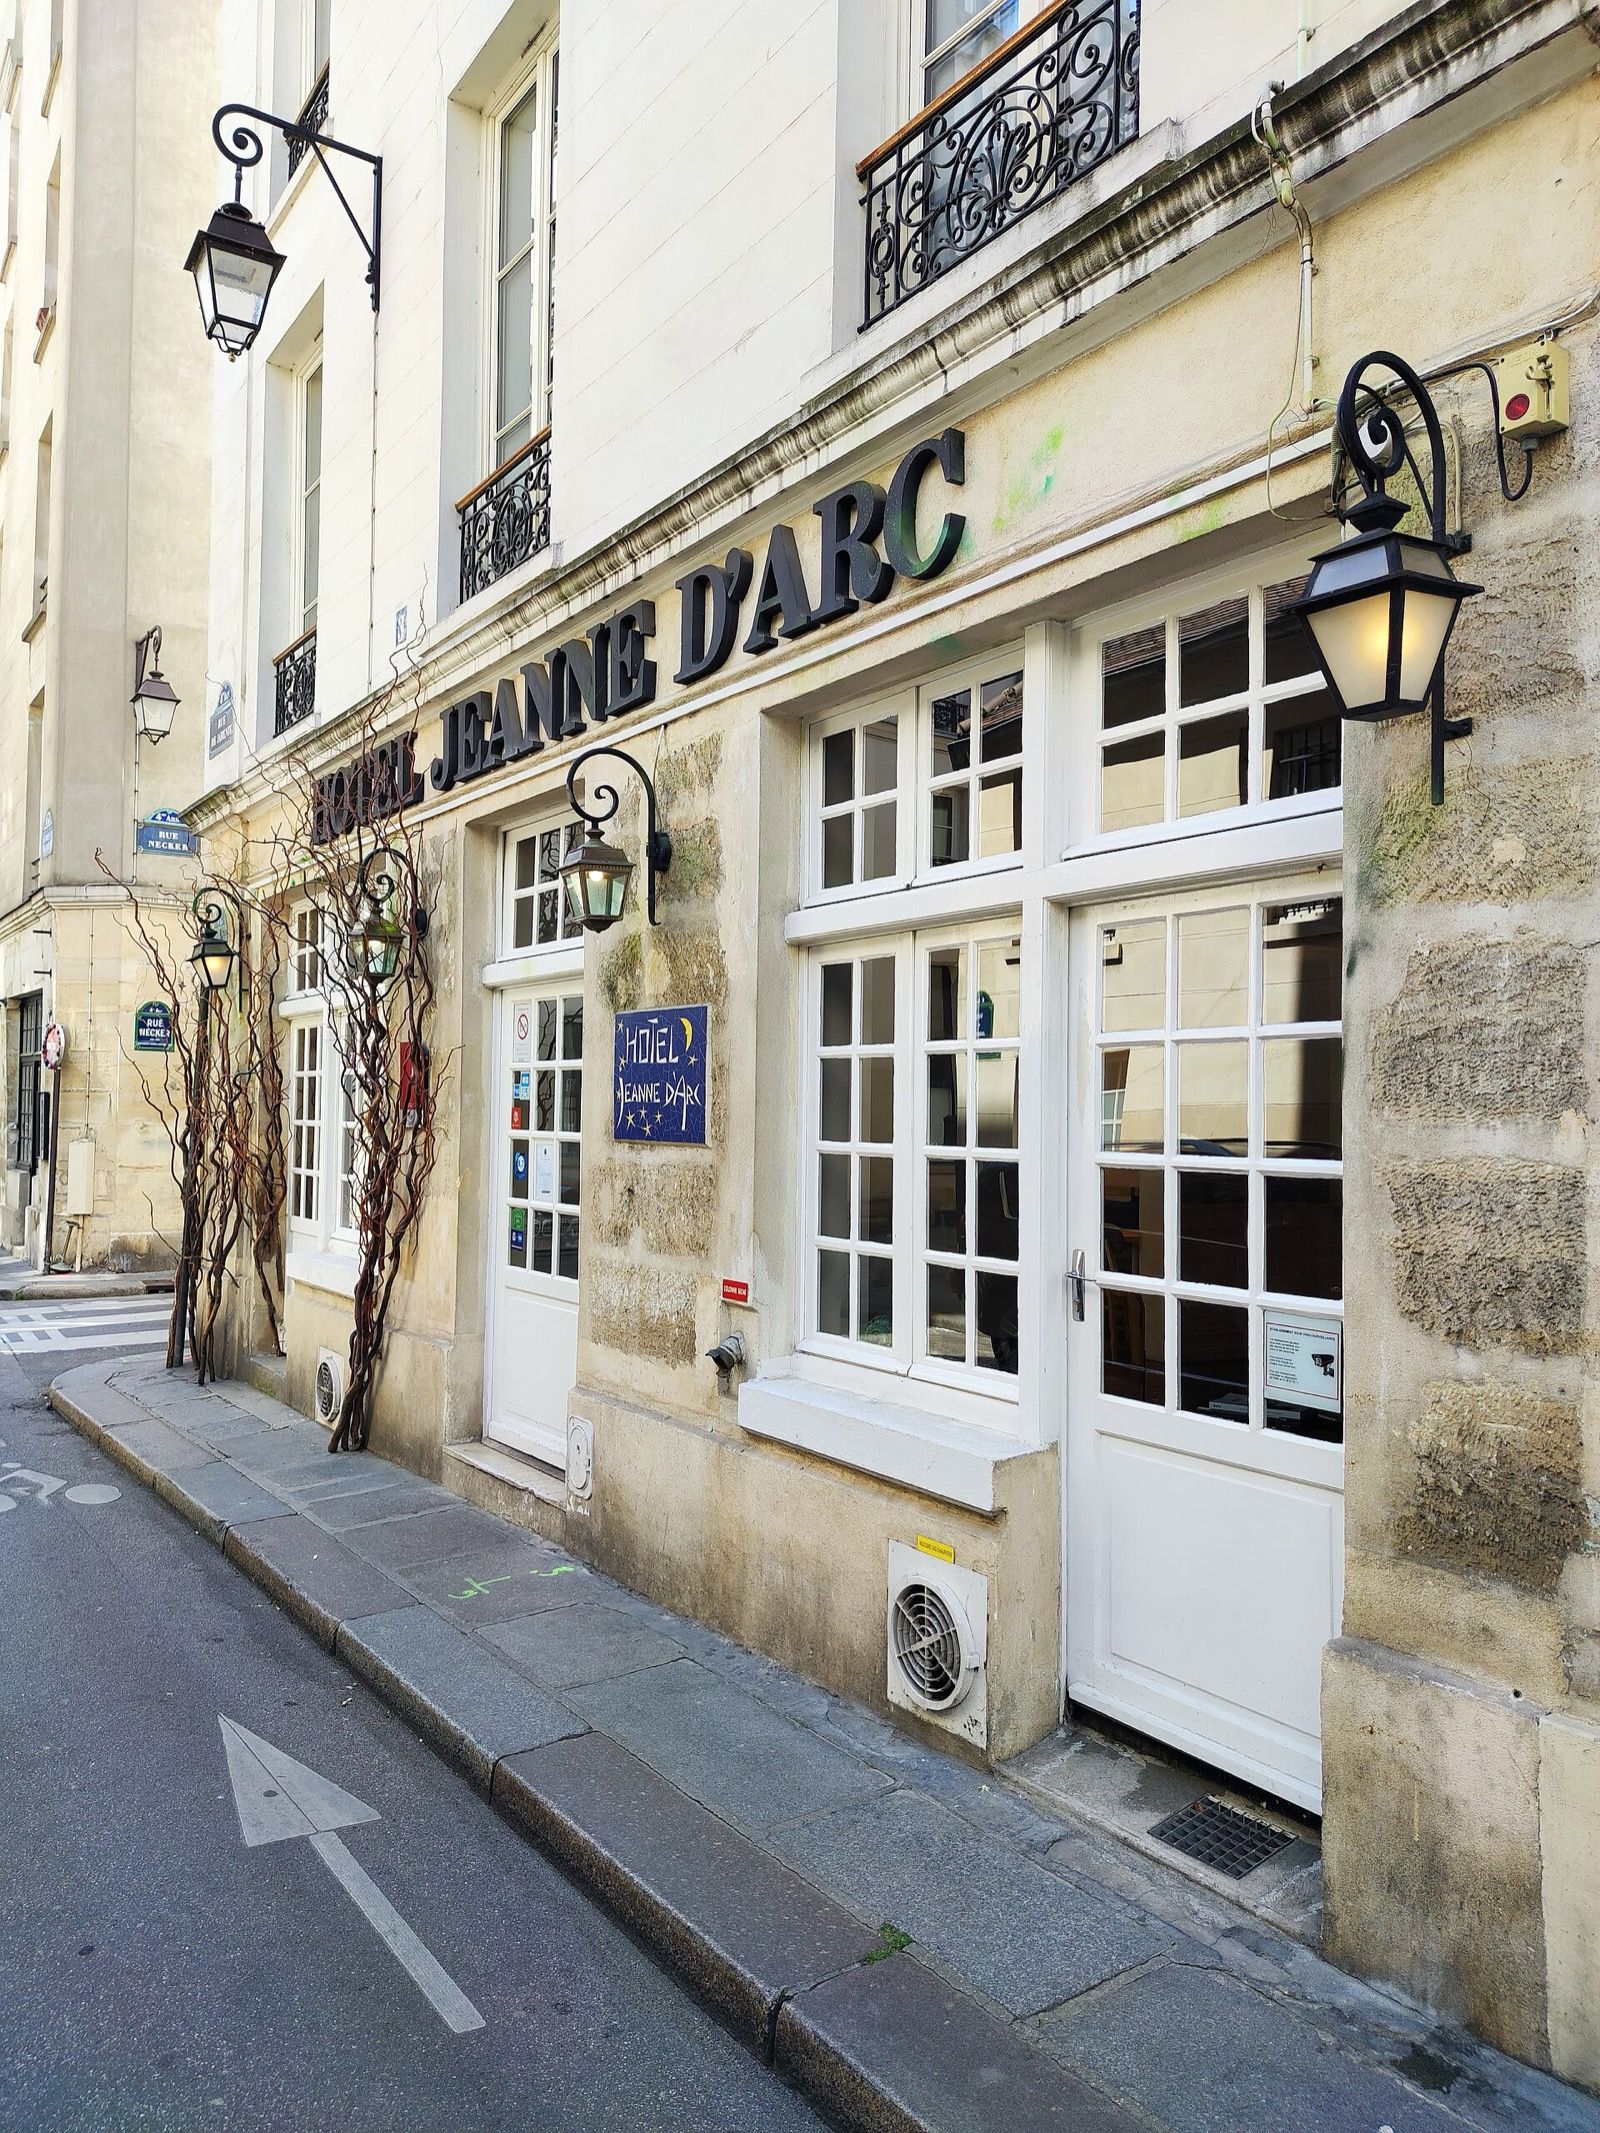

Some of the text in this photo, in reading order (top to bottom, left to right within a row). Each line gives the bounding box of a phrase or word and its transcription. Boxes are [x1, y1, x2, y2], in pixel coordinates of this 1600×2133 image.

[312, 428, 965, 845] HOTEL JEANNE D'ARC
[158, 830, 179, 840] RUE
[148, 840, 189, 851] NECKER
[146, 1018, 164, 1027] RUE
[138, 1028, 171, 1038] NECKER
[615, 1065, 661, 1131] JEANNE
